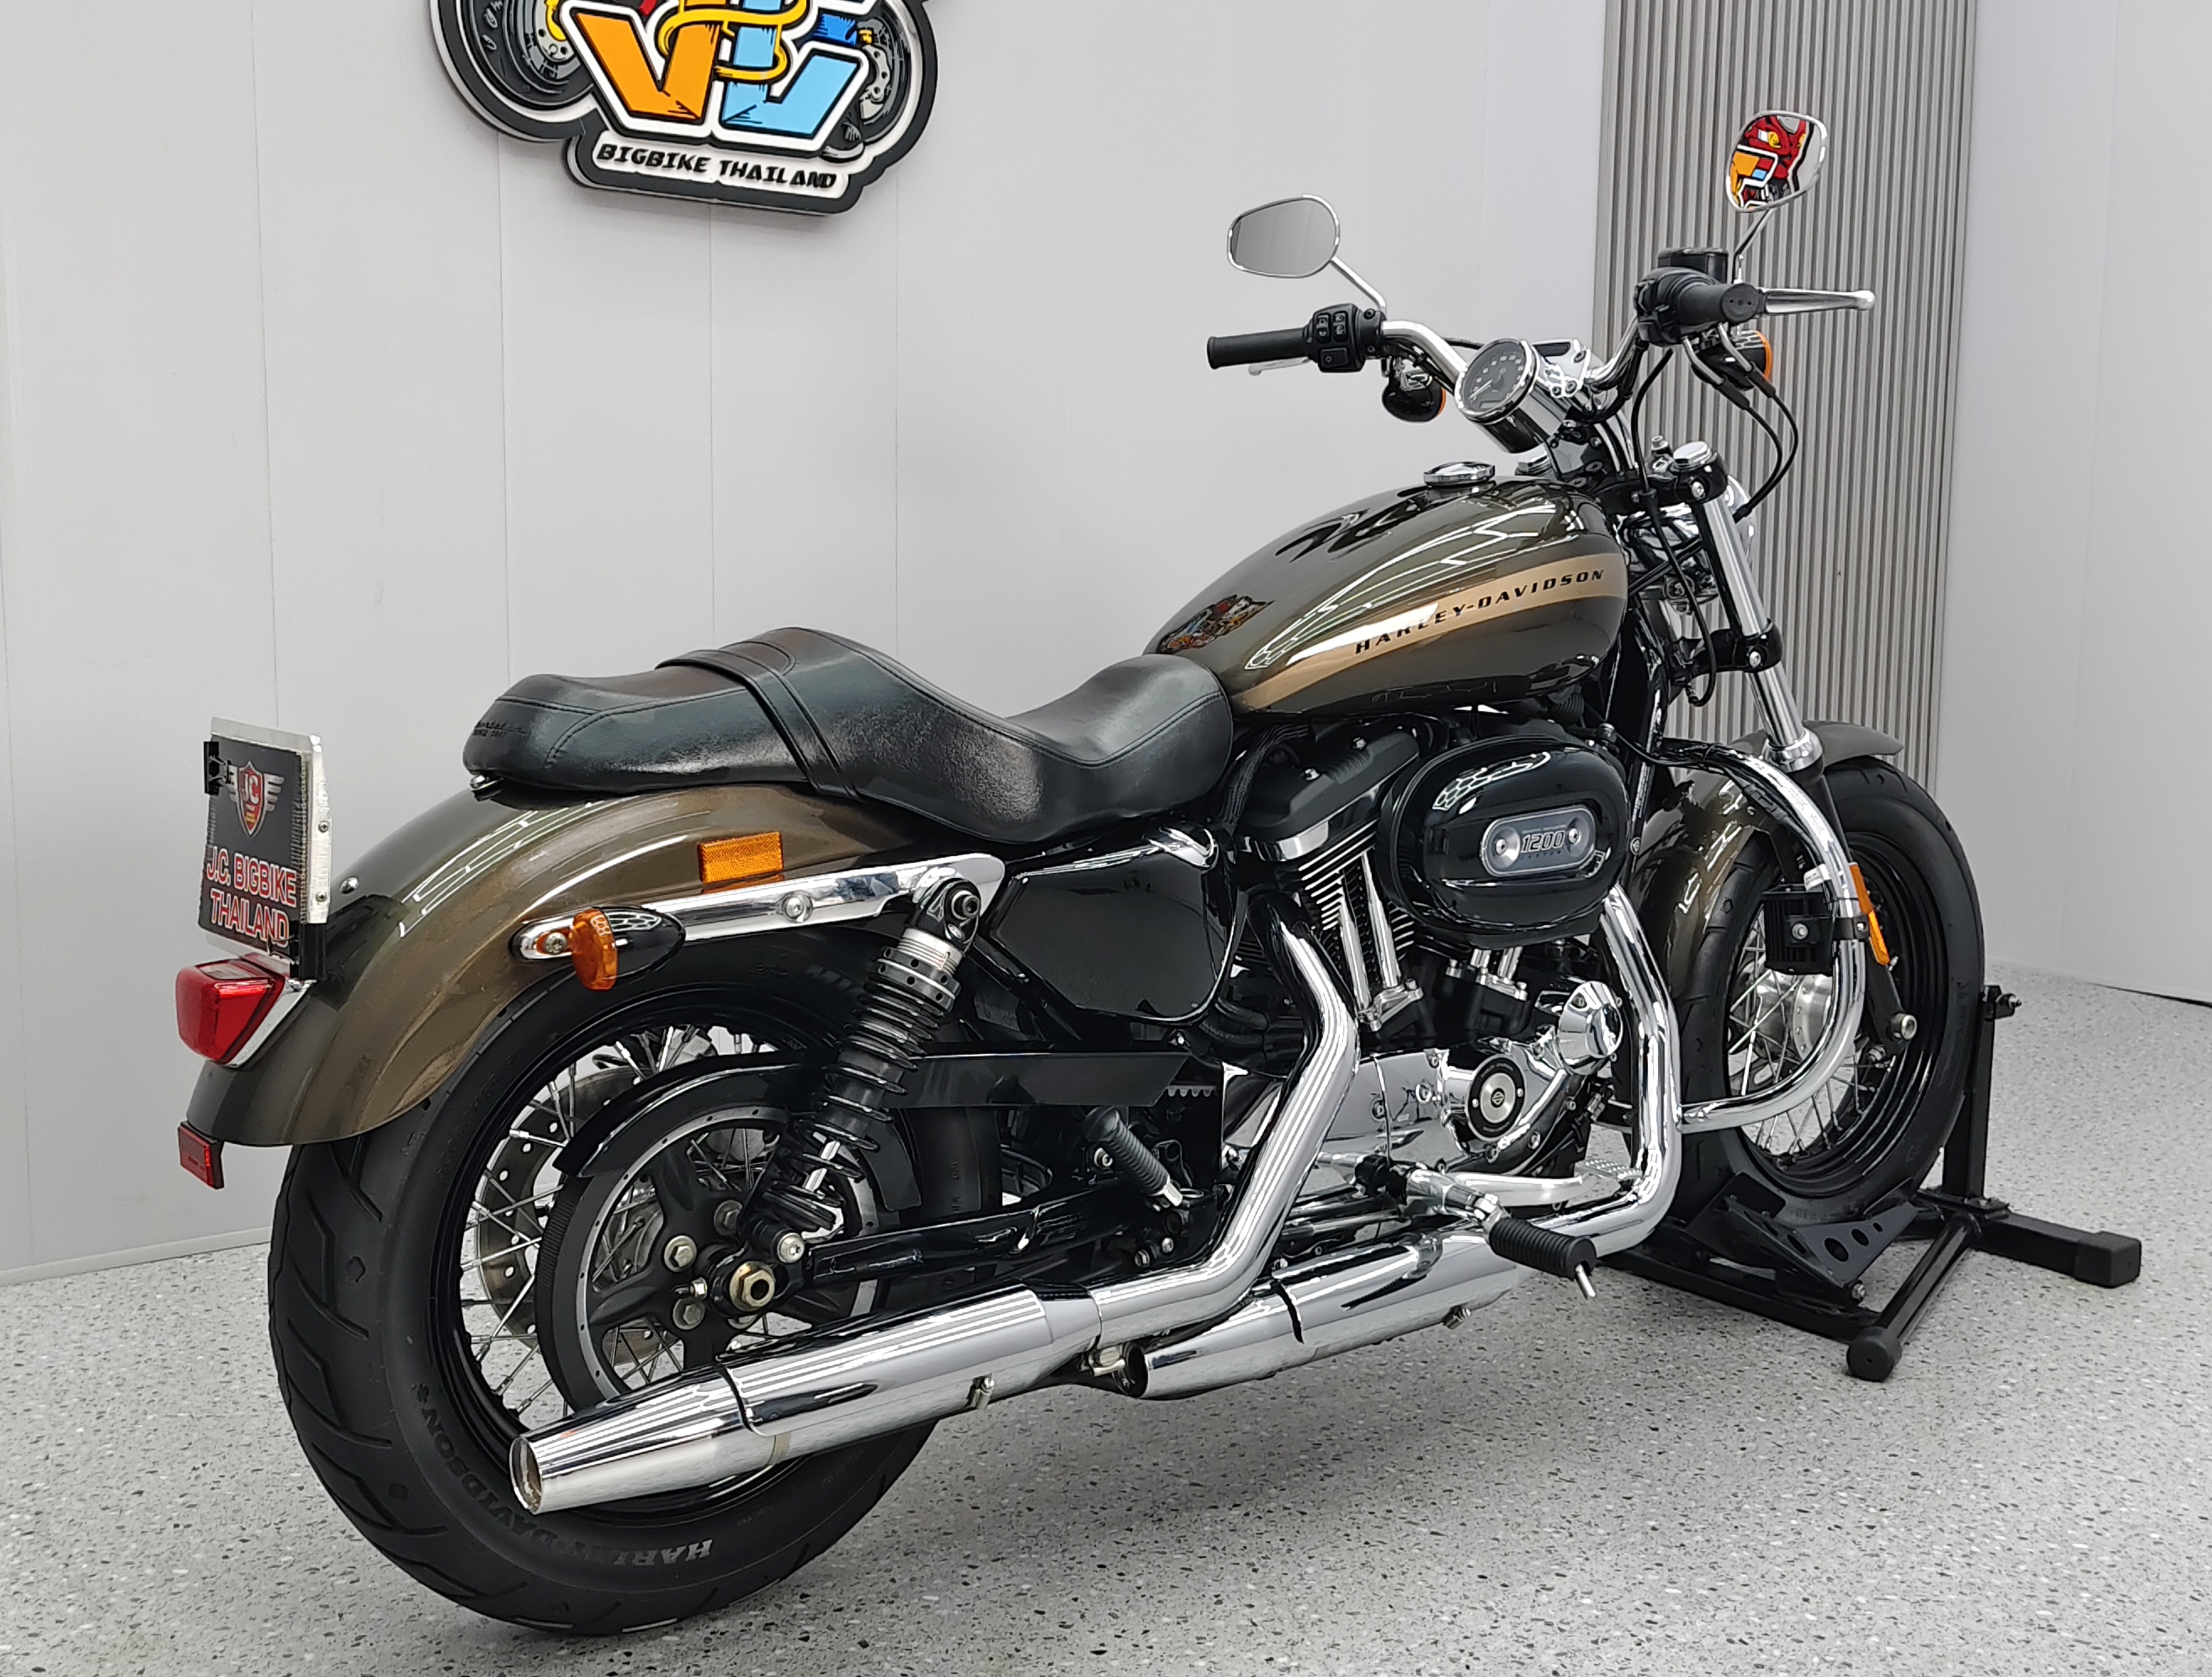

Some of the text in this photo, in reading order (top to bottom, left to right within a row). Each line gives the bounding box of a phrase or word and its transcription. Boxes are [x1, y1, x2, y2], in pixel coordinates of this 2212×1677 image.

[597, 143, 837, 188] BIGBIKE THAILAND
[241, 773, 259, 804] JC
[1520, 830, 1566, 853] 1200
[207, 846, 296, 908] J.C. BIGBIKE
[211, 888, 289, 948] THAILAND
